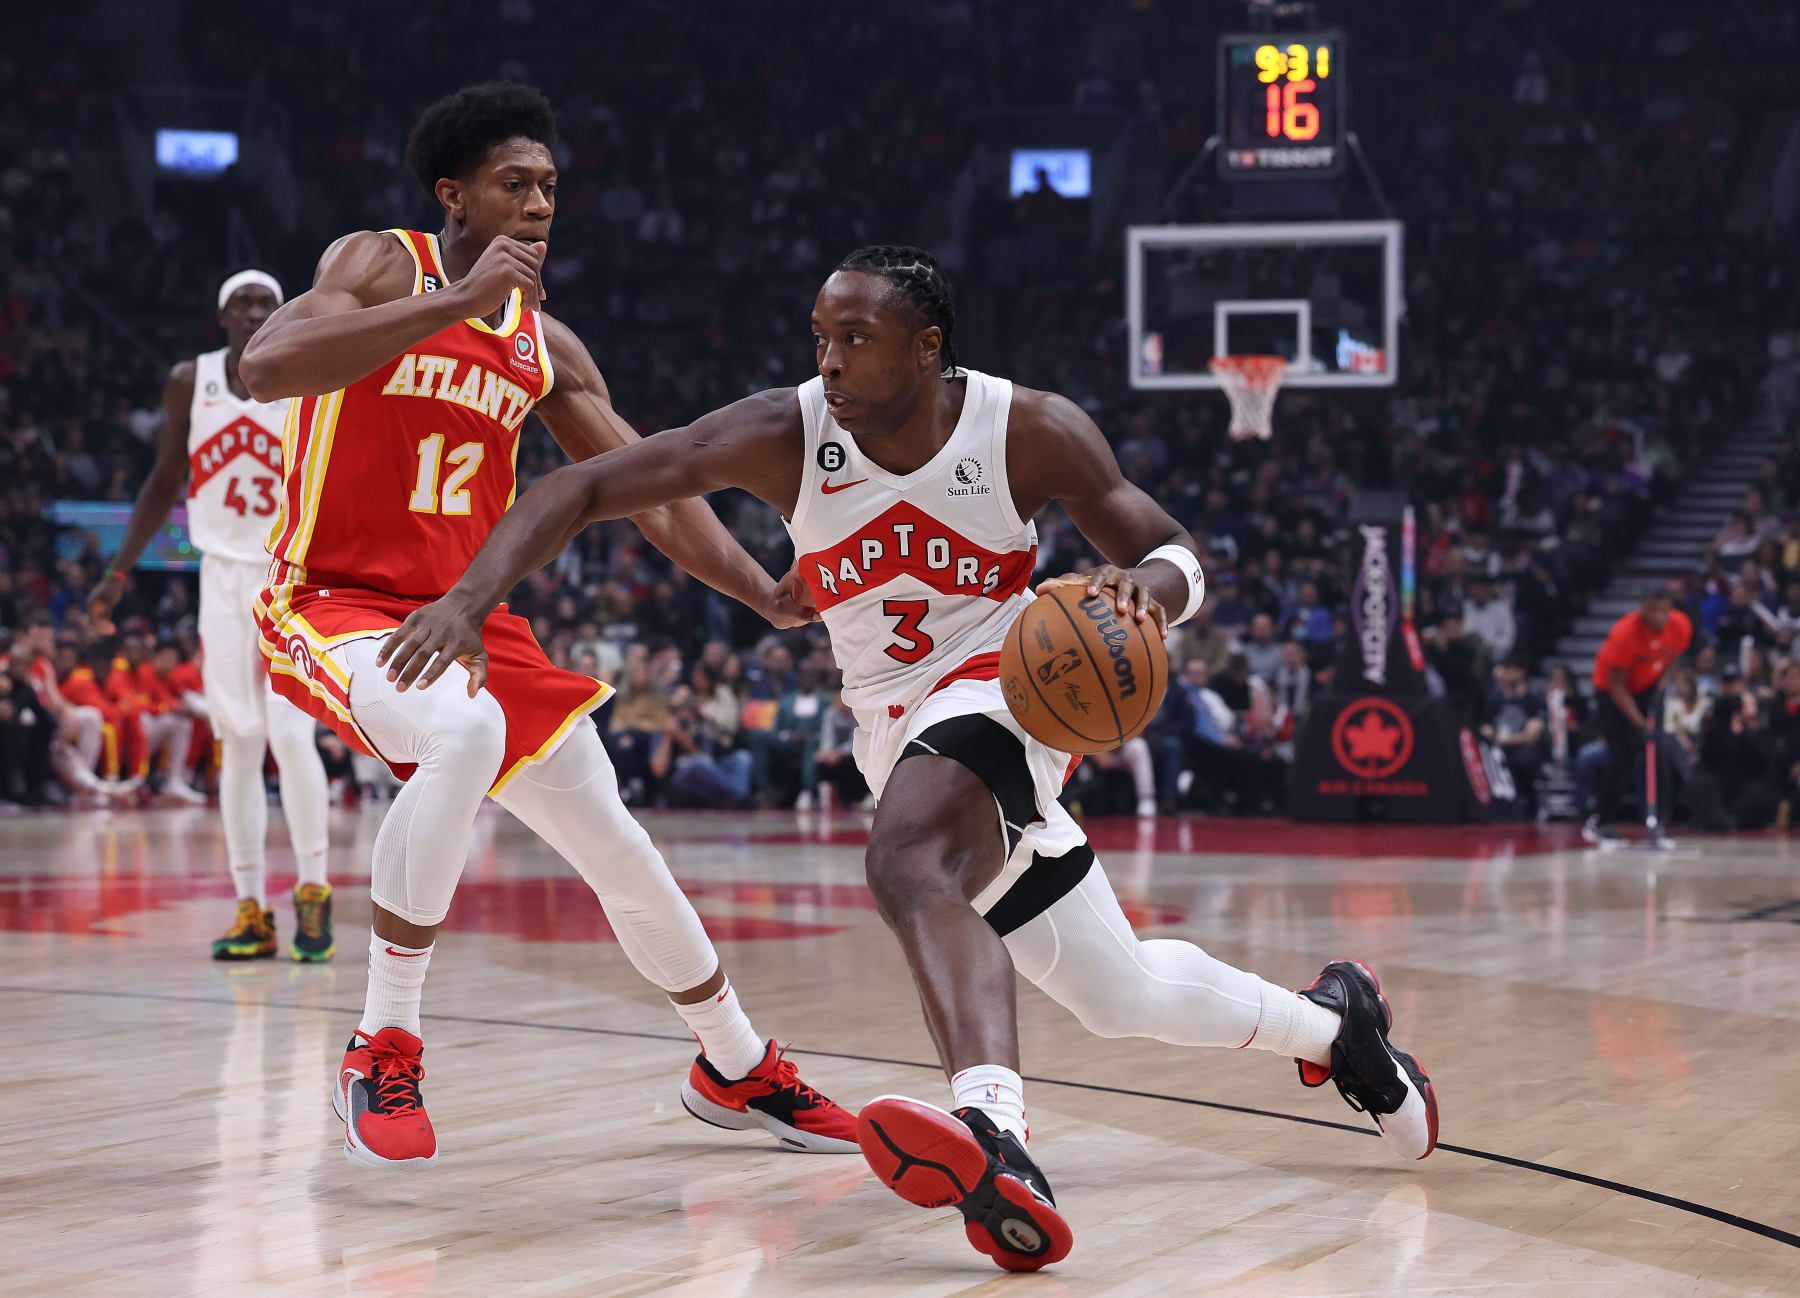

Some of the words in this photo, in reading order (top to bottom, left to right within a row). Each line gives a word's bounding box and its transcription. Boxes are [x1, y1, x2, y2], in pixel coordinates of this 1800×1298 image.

[1255, 44, 1329, 83] 9:31
[1266, 79, 1319, 140] 16
[424, 275, 436, 293] 6
[200, 424, 282, 474] RAPTOR
[408, 432, 485, 516] 12
[824, 446, 840, 468] 6
[223, 476, 277, 518] 43
[947, 487, 969, 497] Sun
[971, 484, 991, 495] Life
[816, 523, 1000, 596] RAPTORS
[882, 599, 934, 665] 3
[1077, 596, 1137, 700] Wilson
